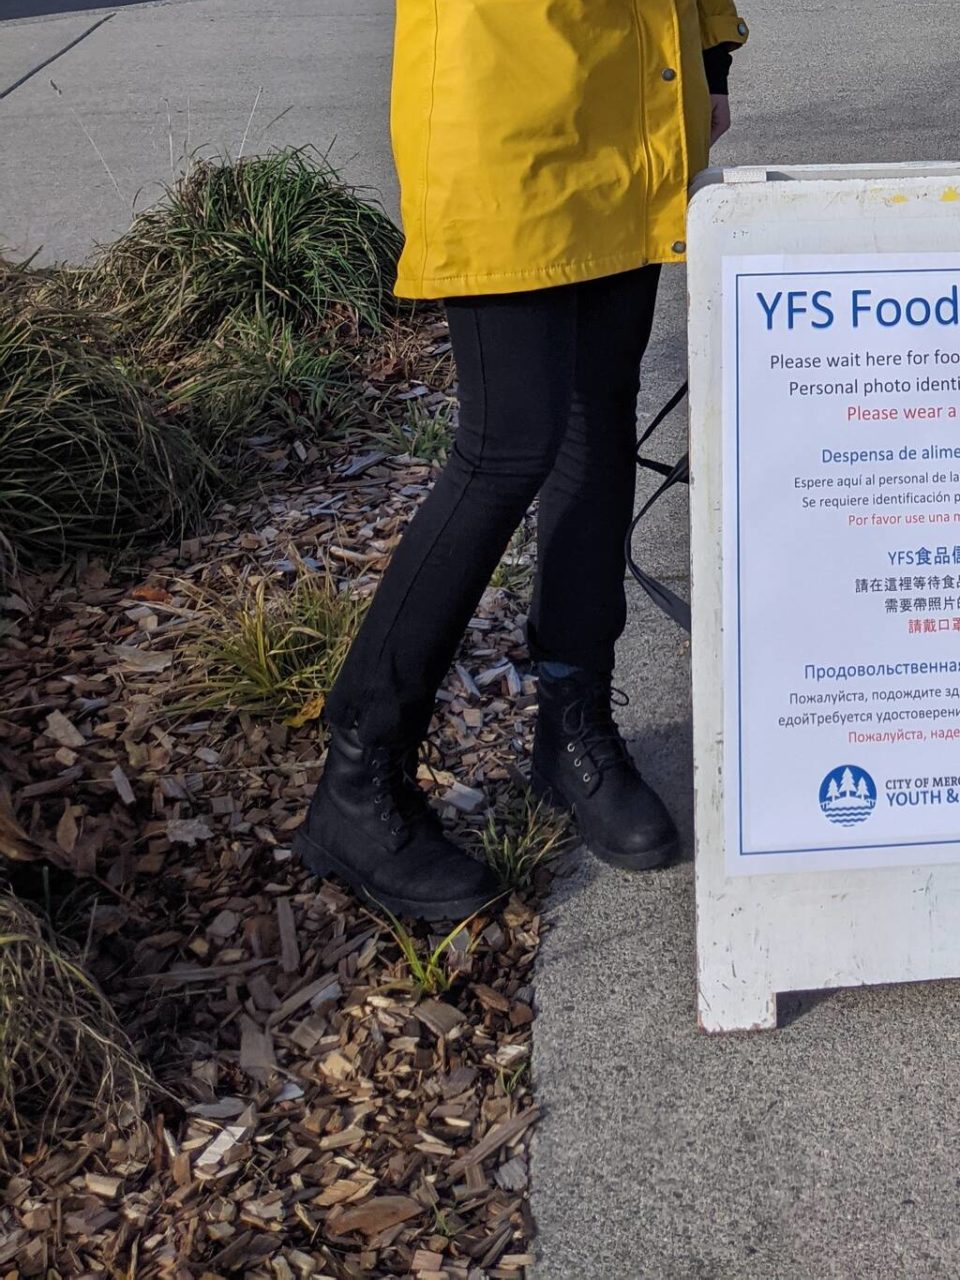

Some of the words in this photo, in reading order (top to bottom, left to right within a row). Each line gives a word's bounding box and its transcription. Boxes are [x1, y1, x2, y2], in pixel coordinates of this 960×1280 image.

[756, 290, 835, 331] YFS
[851, 284, 959, 329] Food
[770, 353, 822, 370] Please
[826, 352, 861, 368] wait
[865, 351, 902, 367] here
[906, 349, 930, 366] for
[789, 378, 858, 396] Personal
[863, 377, 911, 397] photo
[847, 405, 899, 422] Please
[902, 406, 944, 420] wear
[947, 406, 957, 418] a
[822, 448, 894, 466] Despensa
[898, 445, 917, 461] de
[794, 476, 834, 491] Espere
[836, 474, 862, 489] aquí
[865, 473, 876, 486] al
[878, 471, 929, 488] personal
[931, 471, 947, 484] de
[949, 470, 960, 483] la
[802, 496, 817, 509] Se
[819, 496, 870, 510] requiere
[872, 490, 951, 505] identificación
[848, 514, 869, 526] Por
[871, 513, 902, 525] favor
[904, 514, 926, 524] use
[928, 513, 951, 523] una
[789, 692, 868, 706] Пожалуйста,
[871, 688, 942, 703] подождите
[778, 710, 873, 729] едойТребуется
[848, 728, 927, 744] Пожалуйста,
[885, 778, 912, 791] CITY
[914, 777, 930, 789] OF
[886, 789, 942, 807] YOUTH
[946, 787, 960, 804] &
